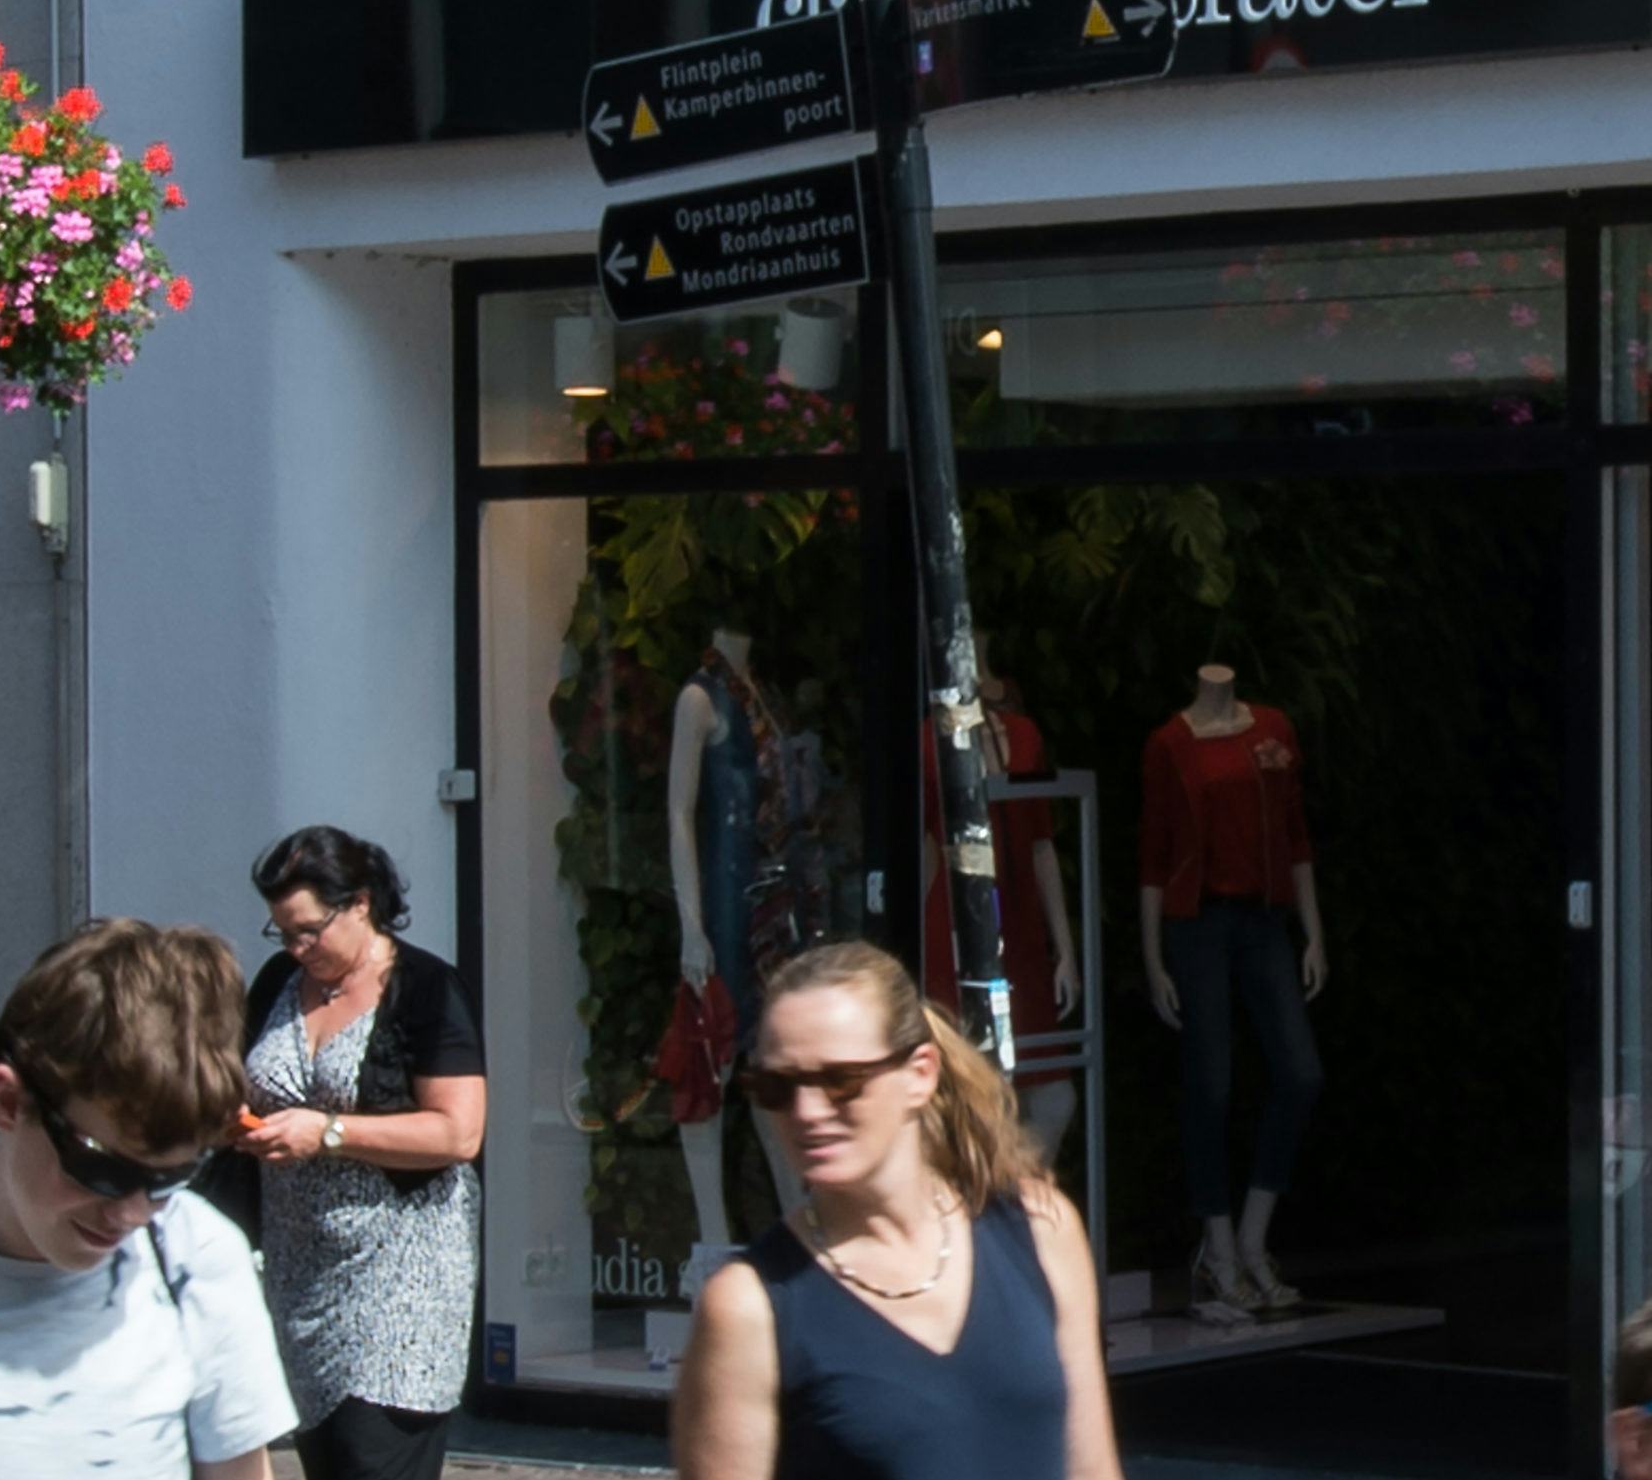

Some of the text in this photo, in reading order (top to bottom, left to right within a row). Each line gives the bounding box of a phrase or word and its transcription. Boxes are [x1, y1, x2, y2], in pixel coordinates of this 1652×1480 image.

[660, 47, 763, 89] Flintplein
[664, 71, 826, 121] Kamperbinnen-
[784, 95, 845, 133] poort
[675, 188, 816, 234] Opstapplaats
[720, 213, 856, 256] Rondvaarten
[681, 248, 841, 294] Mondriaanhuis
